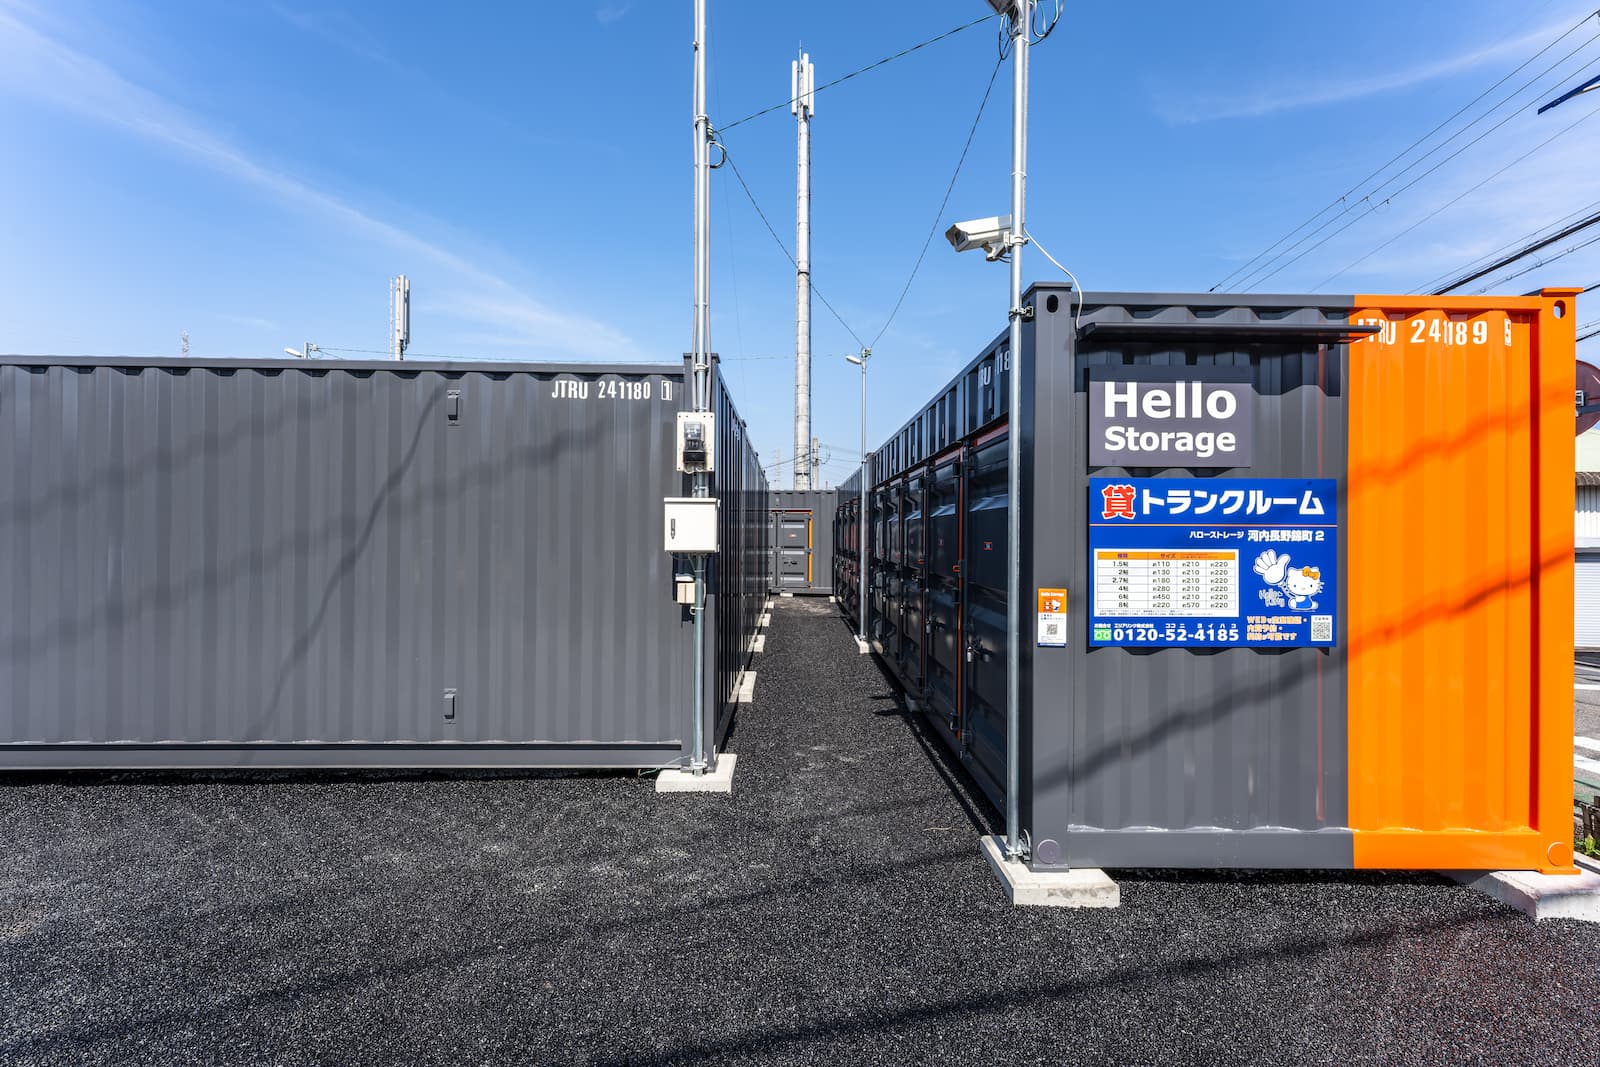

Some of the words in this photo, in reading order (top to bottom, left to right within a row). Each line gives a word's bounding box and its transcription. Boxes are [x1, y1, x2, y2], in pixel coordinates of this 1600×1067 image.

[1410, 318, 1488, 346] 241189
[551, 380, 588, 399] JTRU
[598, 380, 651, 400] 241180
[662, 381, 672, 399] 1
[1104, 380, 1237, 419] Hello
[1104, 425, 1236, 458] Storage
[1189, 530, 1244, 539] ハローストレージ
[1113, 629, 1239, 641] 0120-52-4185
